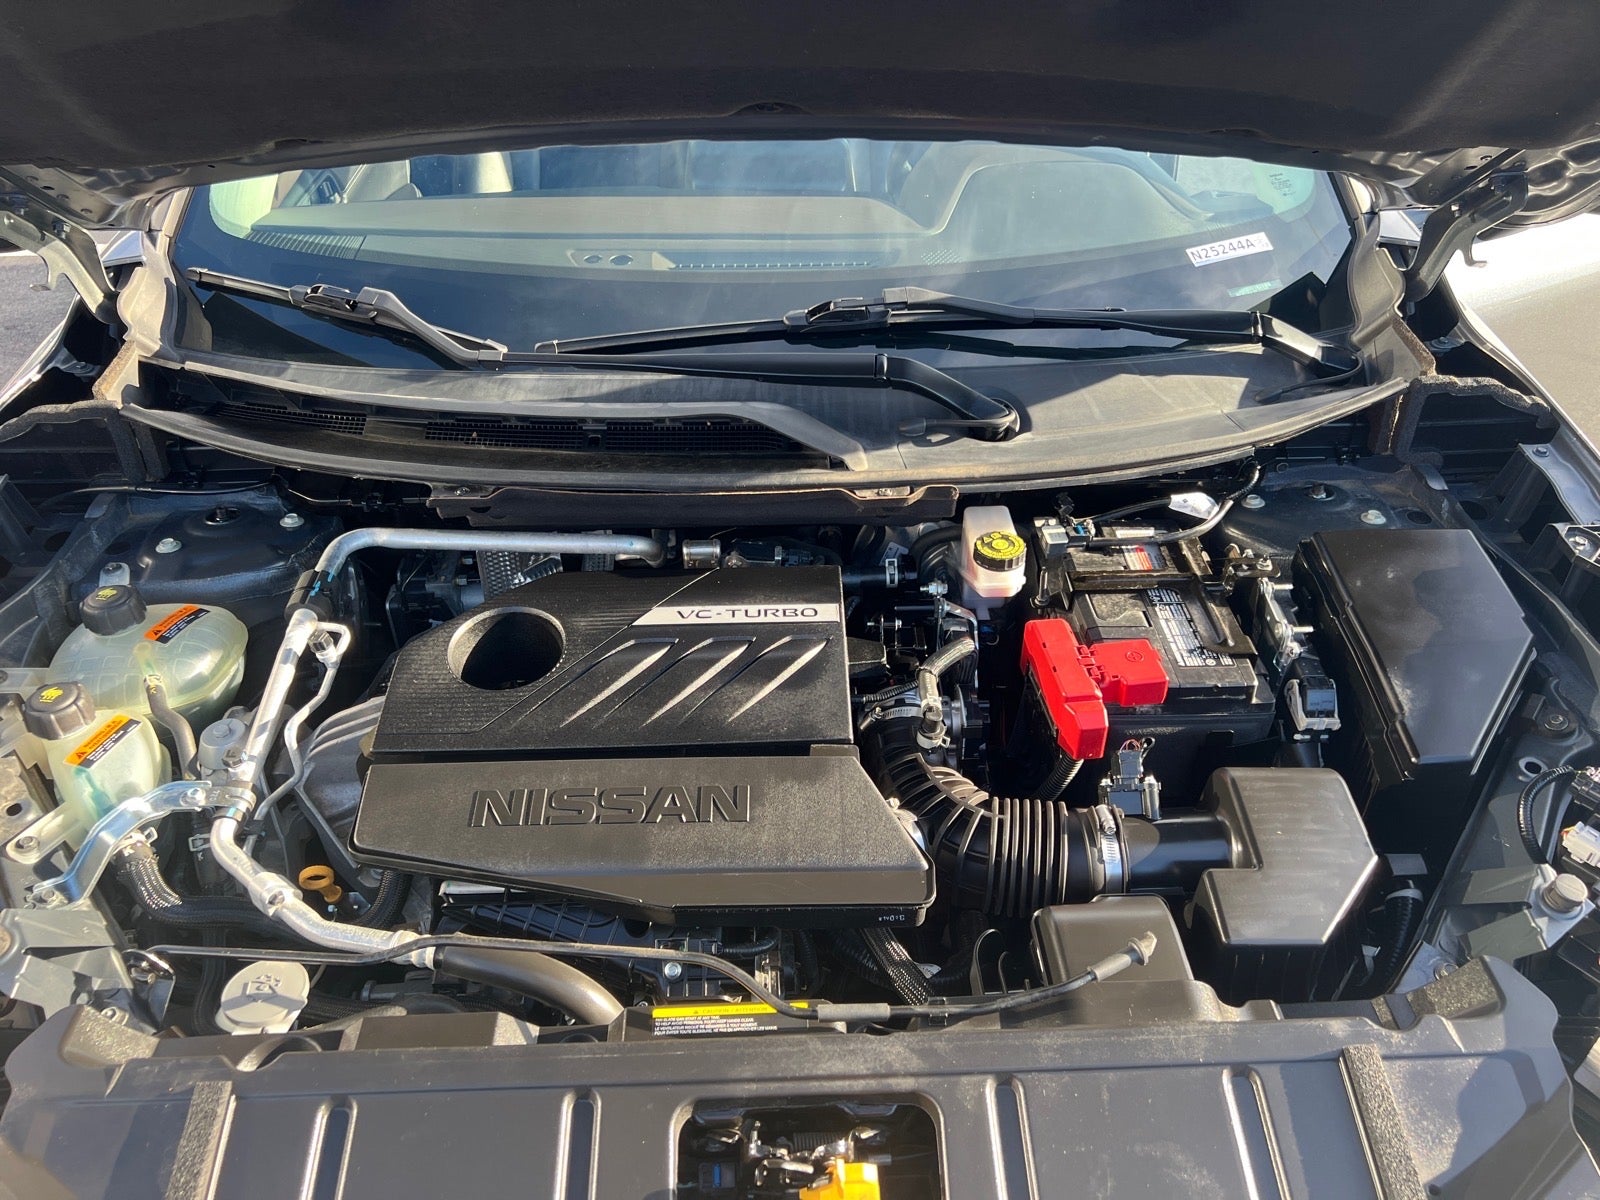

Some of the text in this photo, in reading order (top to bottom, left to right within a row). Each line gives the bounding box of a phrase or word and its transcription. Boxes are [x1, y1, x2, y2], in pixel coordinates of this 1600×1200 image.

[1190, 238, 1256, 261] N25244A
[676, 606, 819, 620] VC-TURBO
[468, 784, 750, 828] NISSAN
